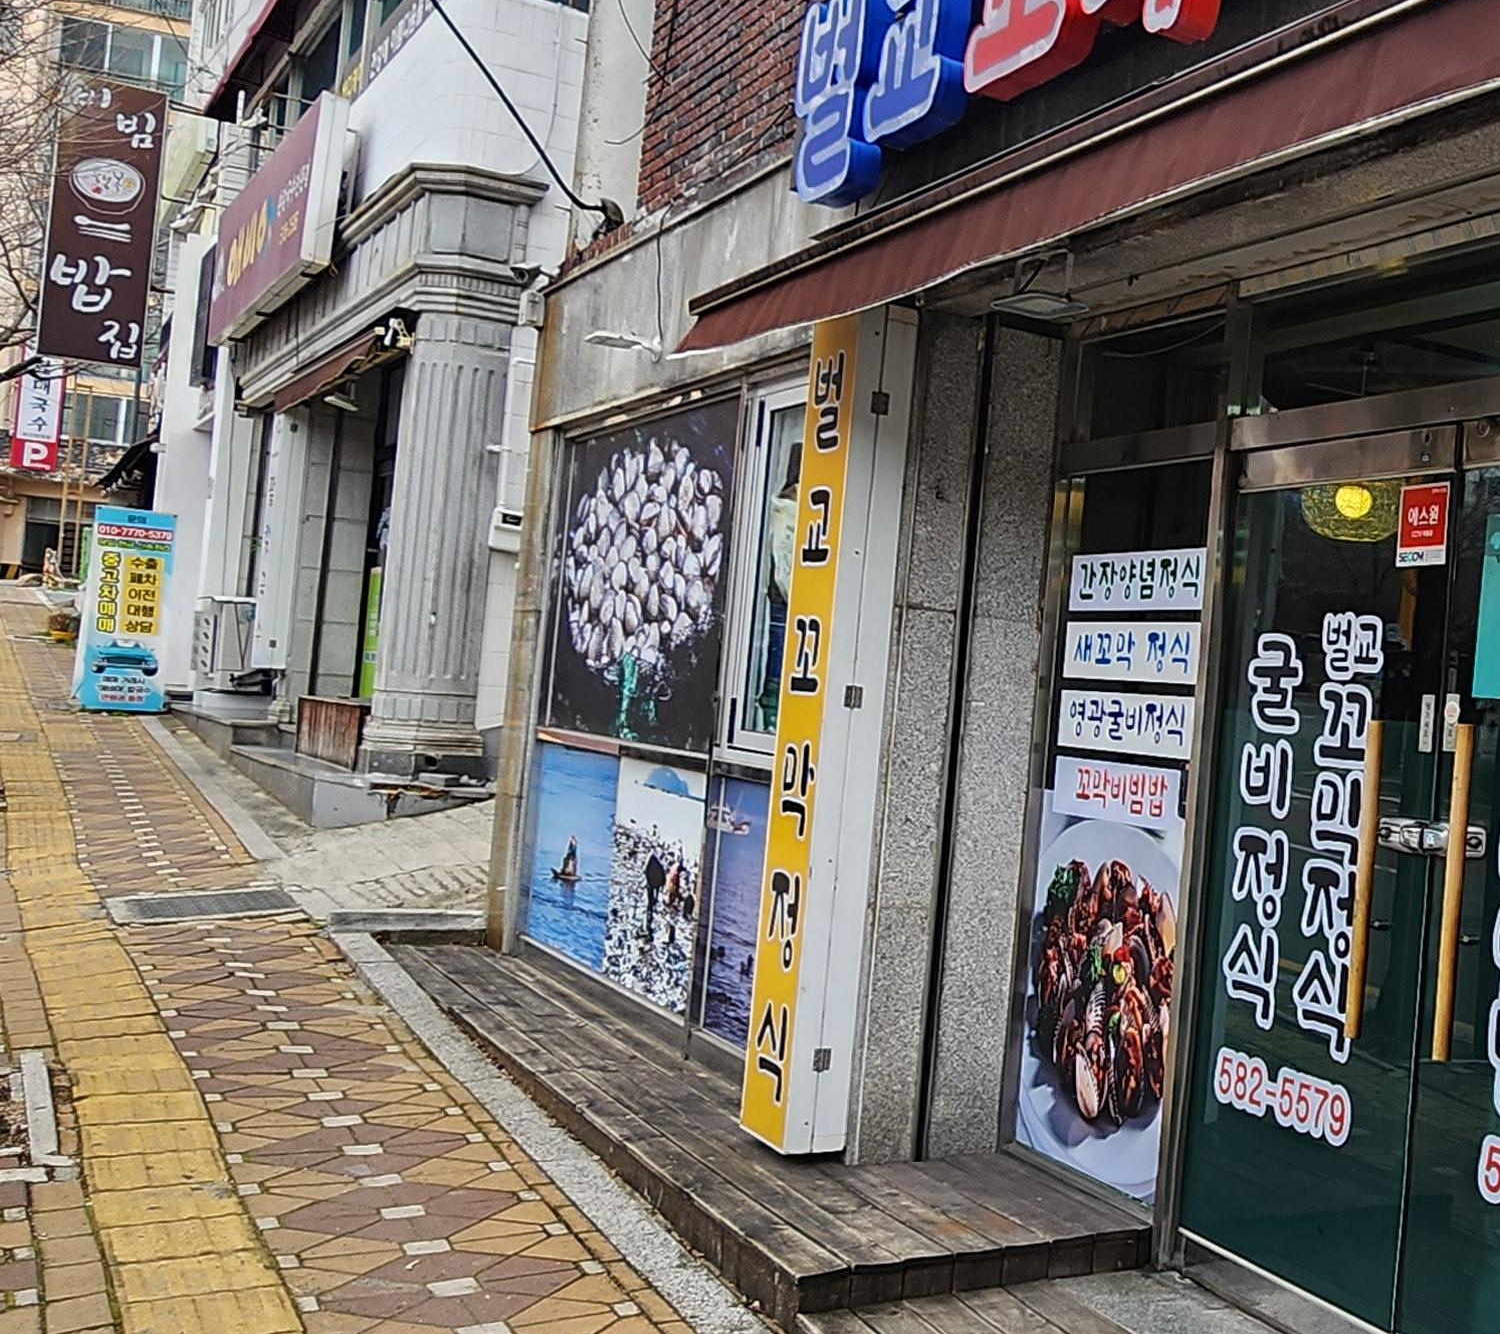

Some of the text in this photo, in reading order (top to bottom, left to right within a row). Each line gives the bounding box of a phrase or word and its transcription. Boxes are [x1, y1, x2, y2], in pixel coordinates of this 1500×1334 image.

[1408, 505, 1440, 526] 에스원
[128, 588, 156, 602] 이전
[1079, 554, 1201, 601] 간장양념정식
[125, 620, 153, 633] 상담
[1324, 614, 1380, 678] 벌교
[1073, 631, 1190, 674] 새꼬막 정식
[755, 350, 846, 1104] 벌교꼬막정식
[1069, 698, 1186, 747] 영광굴비정식
[1075, 767, 1168, 818] 꼬막비빔밥
[1225, 635, 1301, 1029] 굴비정식
[1294, 687, 1373, 1061] 꼬막정식
[1217, 1054, 1348, 1138] 582-5579
